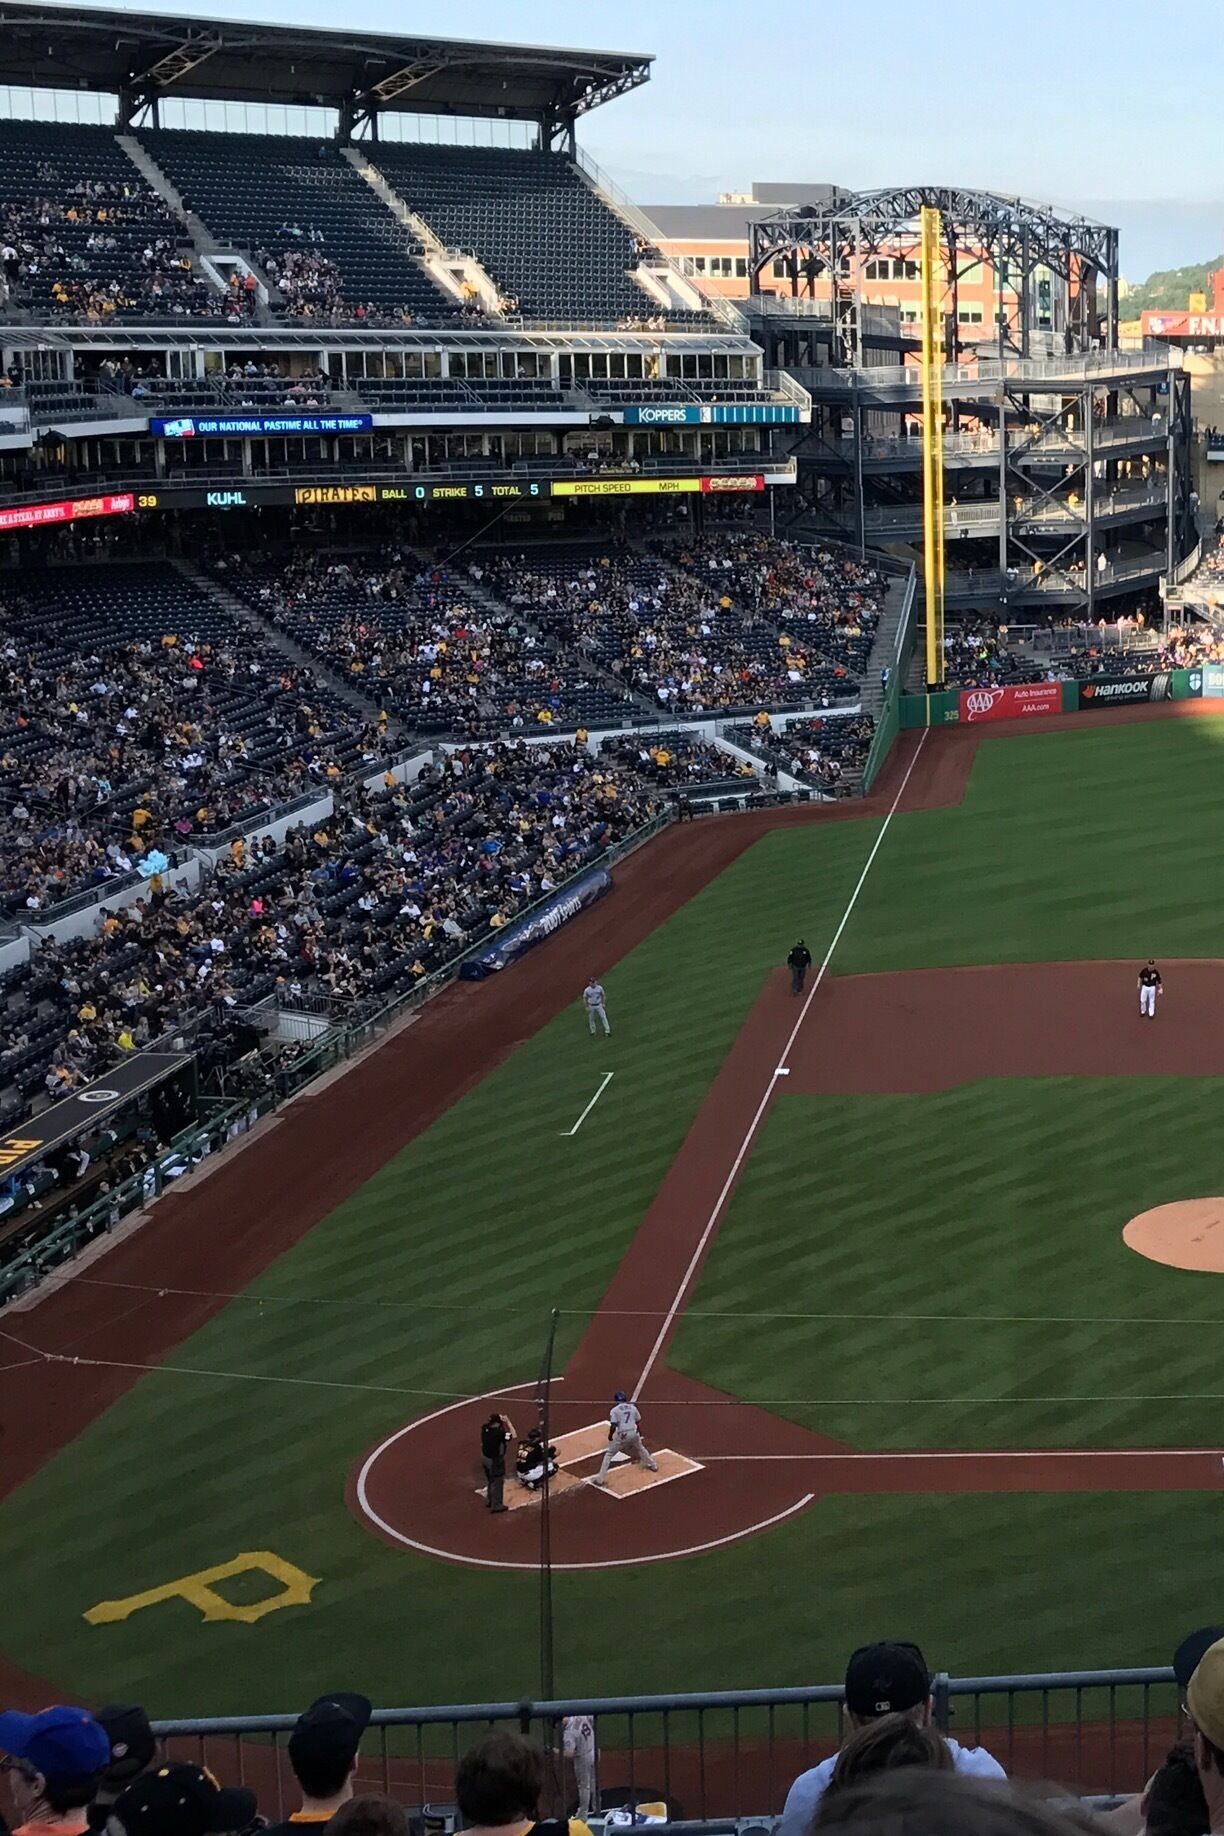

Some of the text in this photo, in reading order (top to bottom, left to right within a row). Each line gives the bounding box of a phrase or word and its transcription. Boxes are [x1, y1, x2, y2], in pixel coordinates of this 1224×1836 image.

[638, 407, 686, 423] KOPPERS
[198, 422, 218, 432] OUR
[220, 422, 262, 432] NATIONAL
[264, 420, 301, 430] PASTIME
[303, 420, 318, 430] ALL
[320, 420, 336, 430] THE
[382, 484, 538, 498] BALL 0 STRIKE 5 TOTAL 5
[574, 482, 680, 493] PITCH SPEED MPH
[138, 495, 156, 507] 39
[207, 492, 246, 506] KUHL
[302, 488, 370, 503] PIRATES
[1014, 688, 1057, 698] Auto Insurance
[1022, 704, 1050, 712] AAA.com
[944, 710, 958, 721] 325
[624, 1412, 630, 1424] 7
